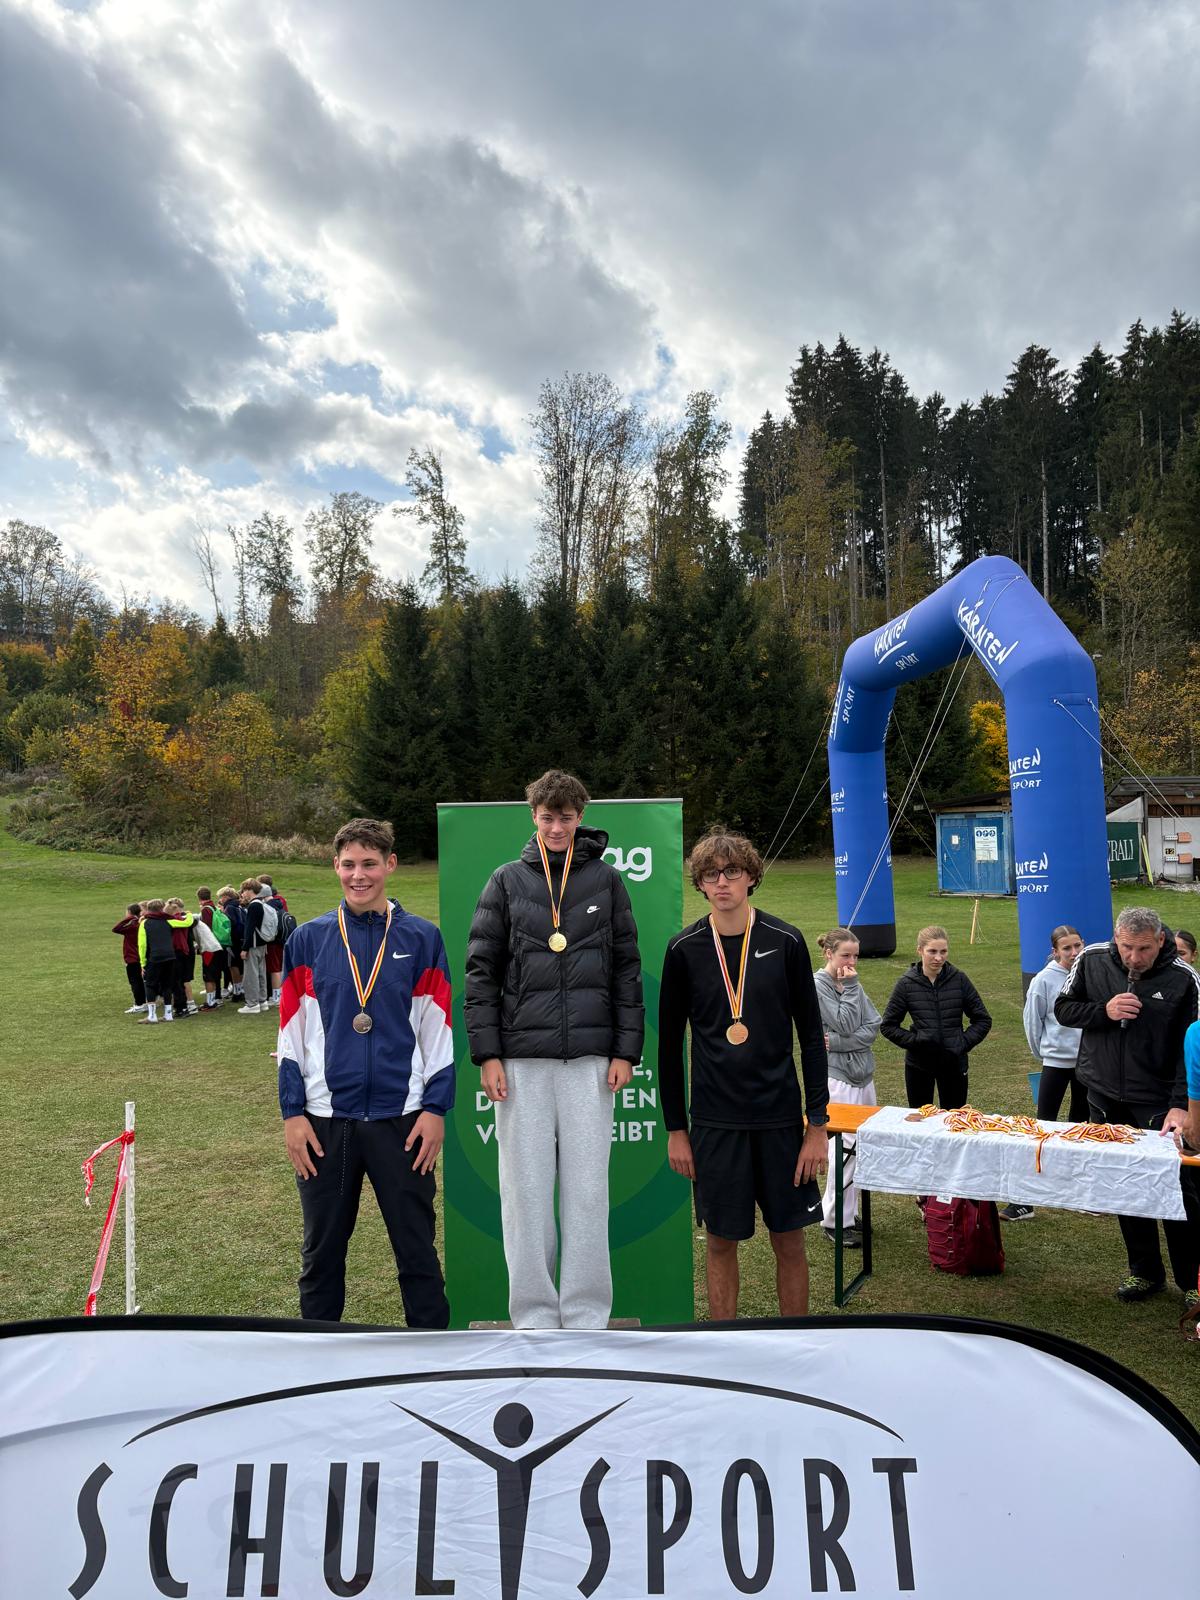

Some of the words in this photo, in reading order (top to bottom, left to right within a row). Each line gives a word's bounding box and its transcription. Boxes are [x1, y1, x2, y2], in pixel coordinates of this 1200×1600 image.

[895, 653, 919, 670] SPORT
[842, 685, 855, 724] SPORT
[1009, 748, 1041, 774] NTEN
[1012, 779, 1042, 790] SPORT
[600, 846, 652, 881] ag
[1015, 852, 1048, 876] NTEN
[1019, 883, 1049, 893] SPORT
[611, 1120, 657, 1142] EIBT
